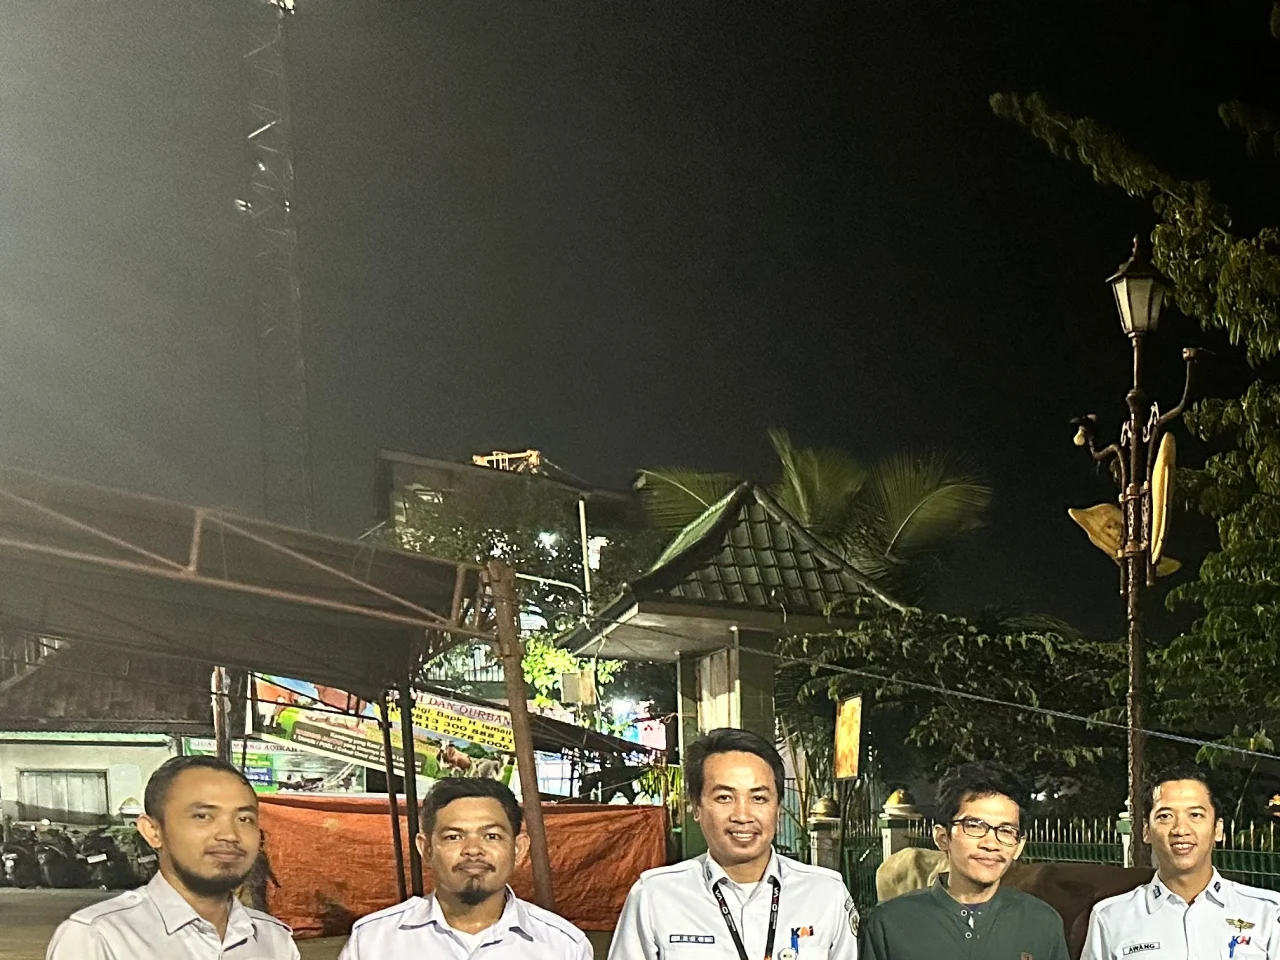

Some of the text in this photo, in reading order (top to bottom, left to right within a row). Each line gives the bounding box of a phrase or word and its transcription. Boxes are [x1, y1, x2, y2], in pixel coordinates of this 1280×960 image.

[460, 705, 512, 725] QURBAN
[444, 720, 467, 732] 300
[479, 738, 510, 750] 2006
[1128, 943, 1156, 954] AWANG
